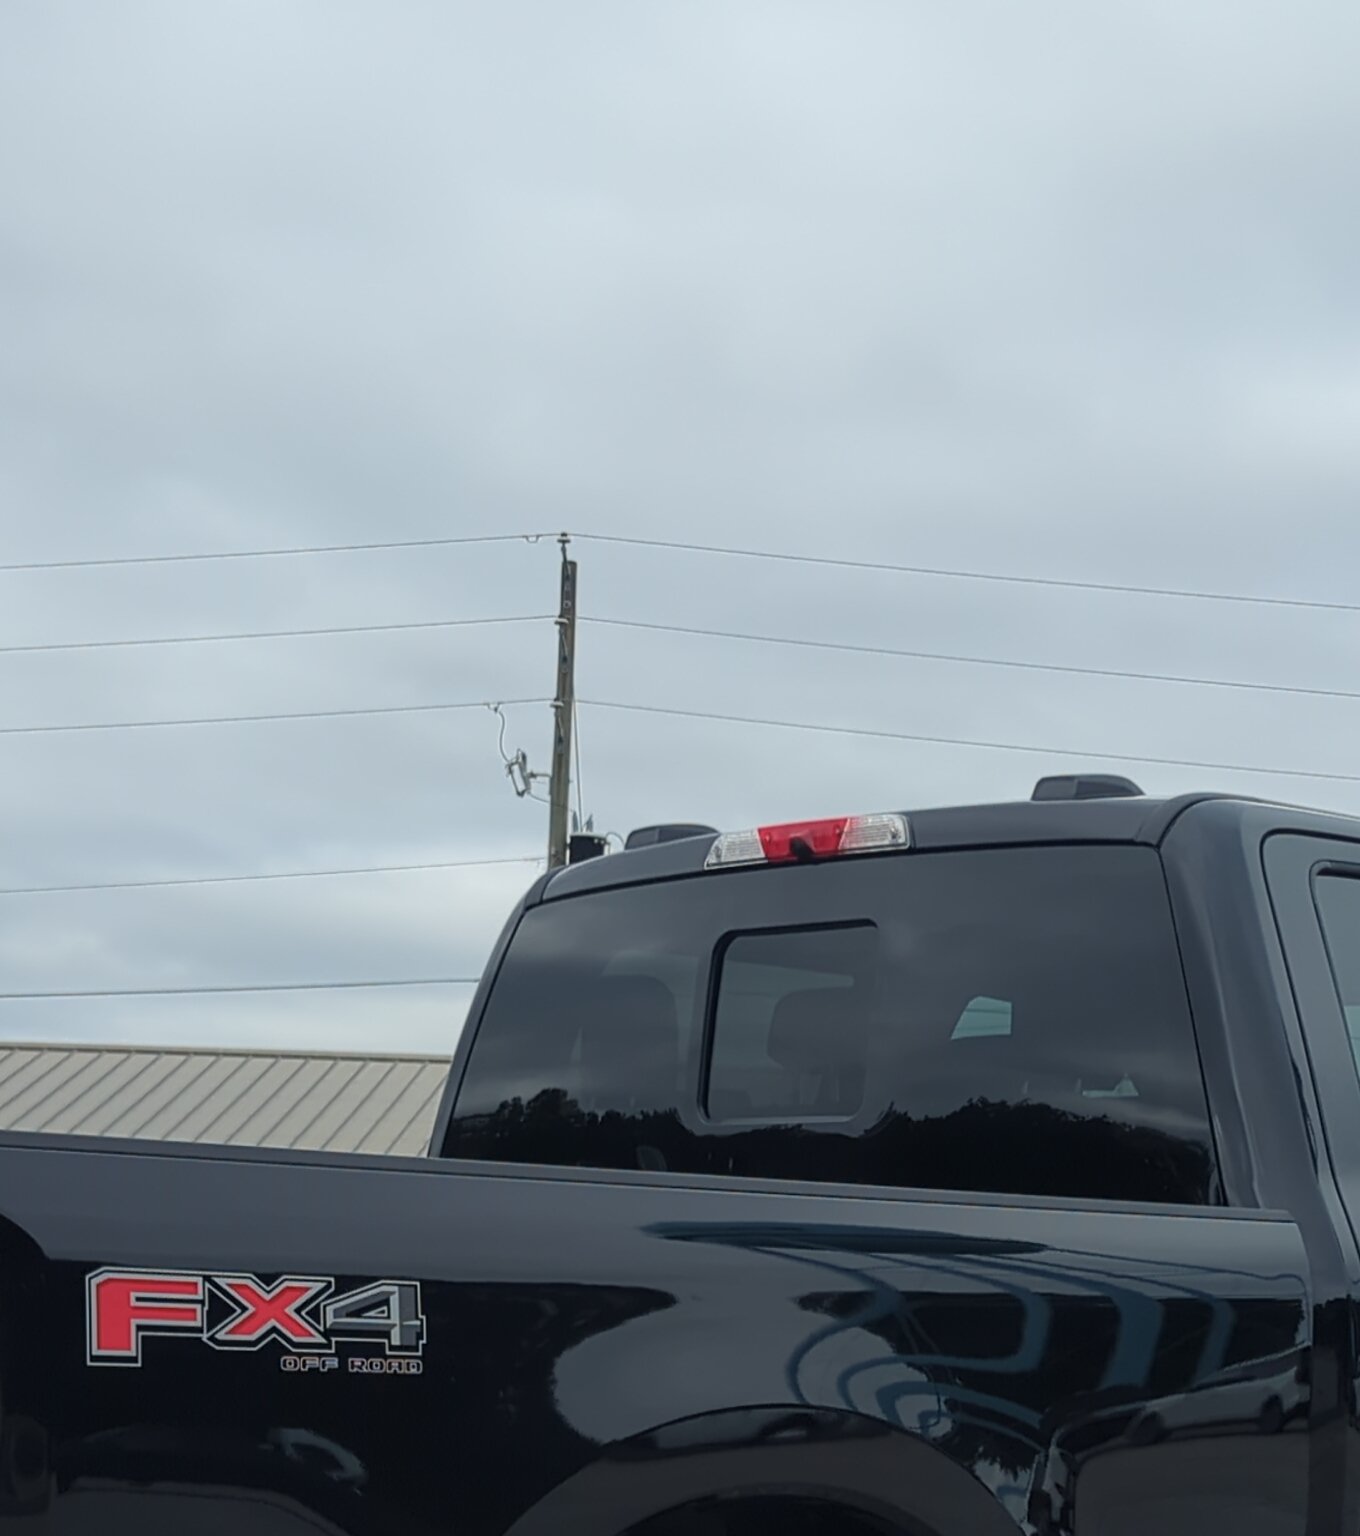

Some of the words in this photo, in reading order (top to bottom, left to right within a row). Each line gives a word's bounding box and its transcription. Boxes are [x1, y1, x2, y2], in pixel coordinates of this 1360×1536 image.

[86, 1266, 426, 1367] FX4
[280, 1356, 339, 1373] OFF
[348, 1357, 424, 1375] ROAD
